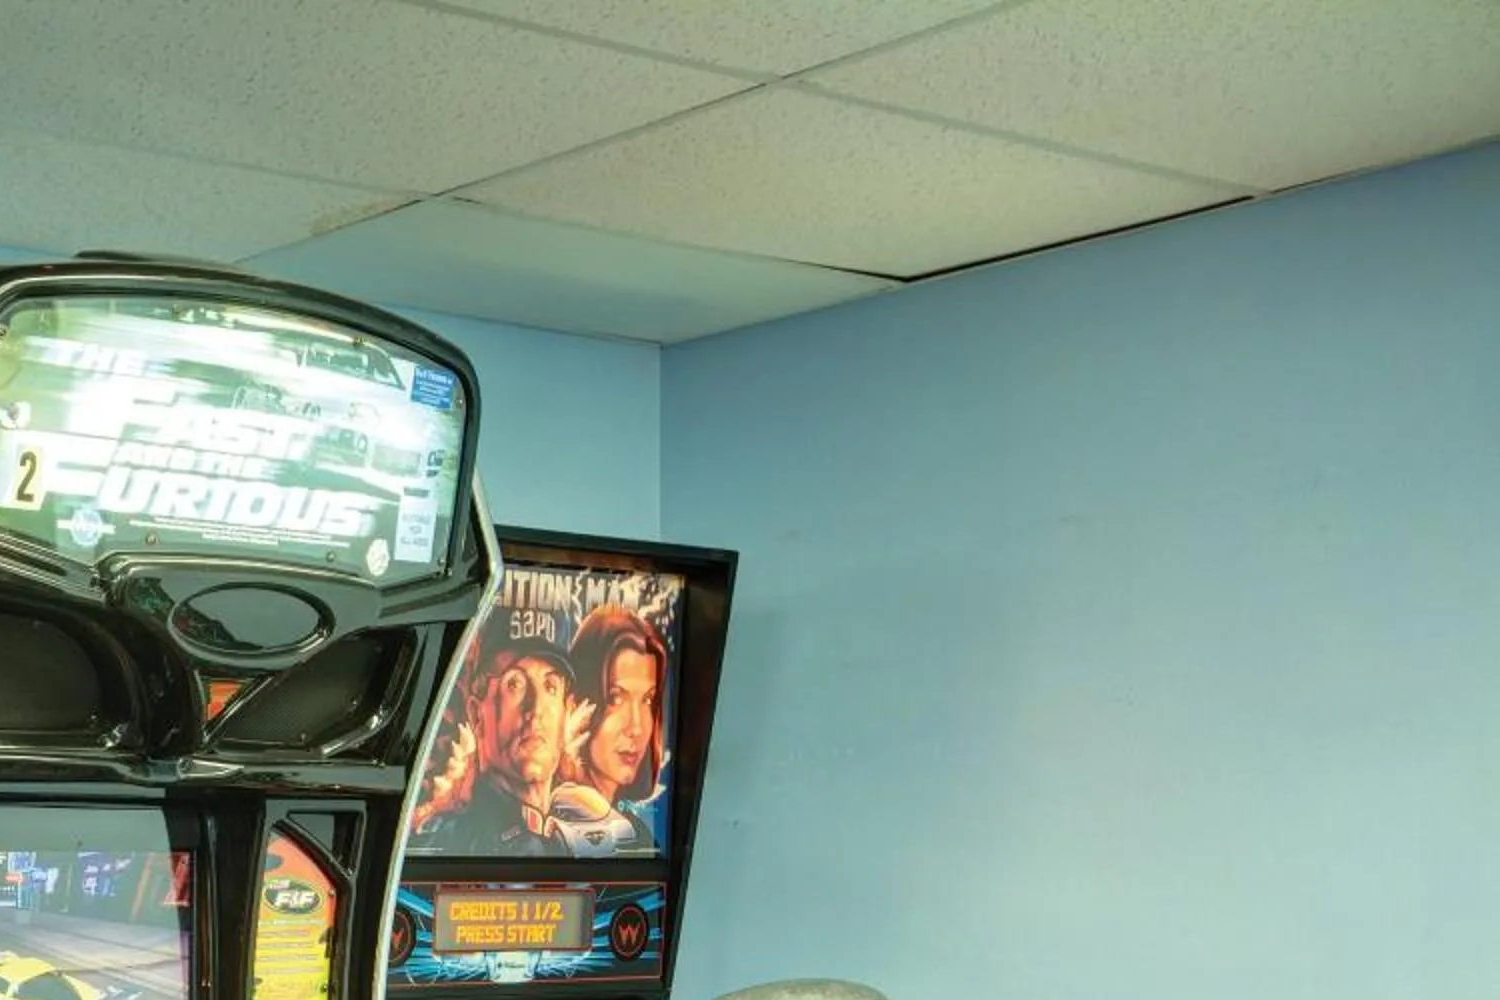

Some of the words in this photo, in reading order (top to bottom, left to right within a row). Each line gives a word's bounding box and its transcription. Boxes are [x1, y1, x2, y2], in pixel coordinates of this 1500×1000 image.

[12, 432, 368, 536] FURIOUS
[15, 449, 37, 504] 2
[502, 569, 573, 610] ITION
[450, 901, 518, 921] CREDITS
[456, 924, 504, 944] PRESS
[507, 924, 557, 944] START
